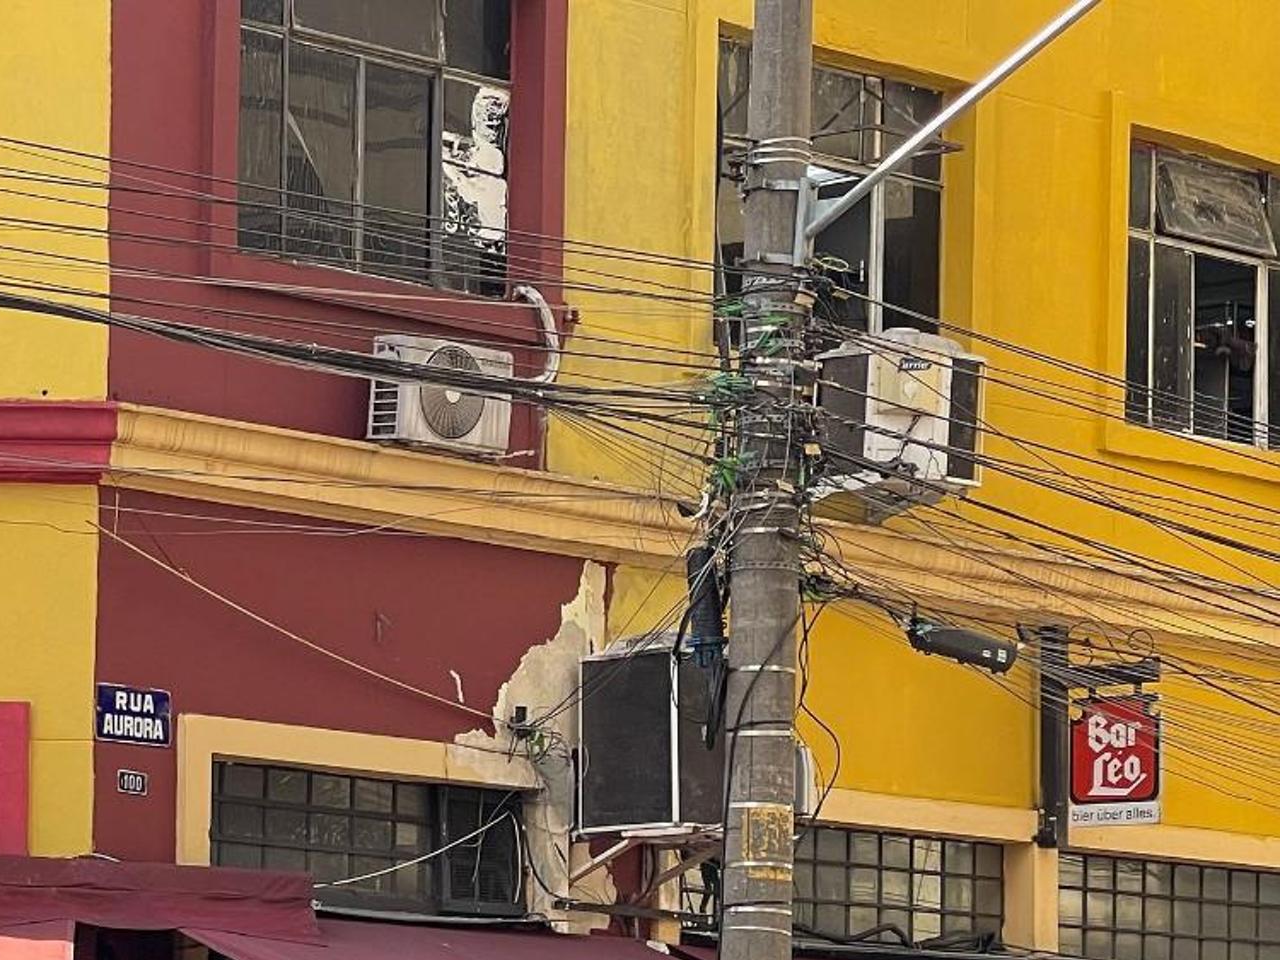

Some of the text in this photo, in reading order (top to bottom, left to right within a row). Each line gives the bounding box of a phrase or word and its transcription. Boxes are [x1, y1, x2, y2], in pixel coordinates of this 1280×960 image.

[115, 691, 154, 714] RUA
[103, 713, 164, 740] AURORA
[1088, 714, 1143, 753] Bar
[123, 774, 142, 791] 100
